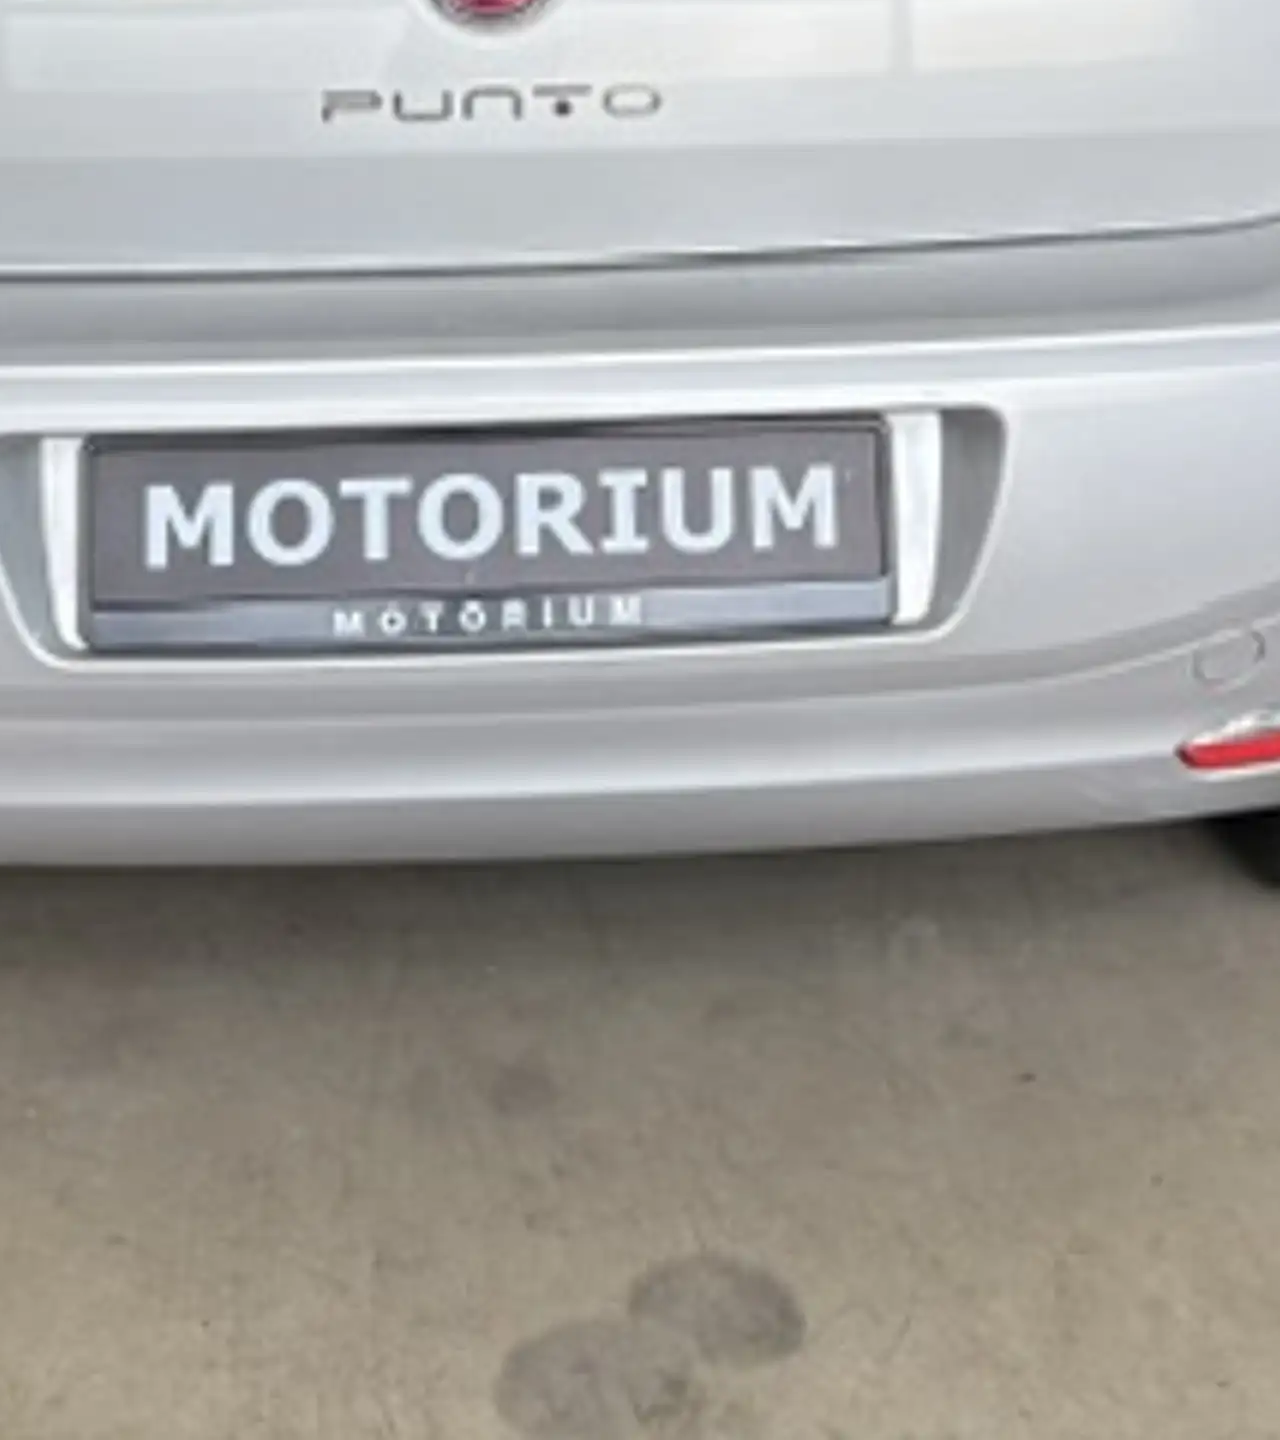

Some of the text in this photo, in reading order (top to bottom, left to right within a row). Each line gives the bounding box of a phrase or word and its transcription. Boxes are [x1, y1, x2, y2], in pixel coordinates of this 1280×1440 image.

[321, 83, 663, 123] PUNTO
[144, 462, 838, 570] MOTORIUM
[332, 594, 642, 637] MOTORIUM
